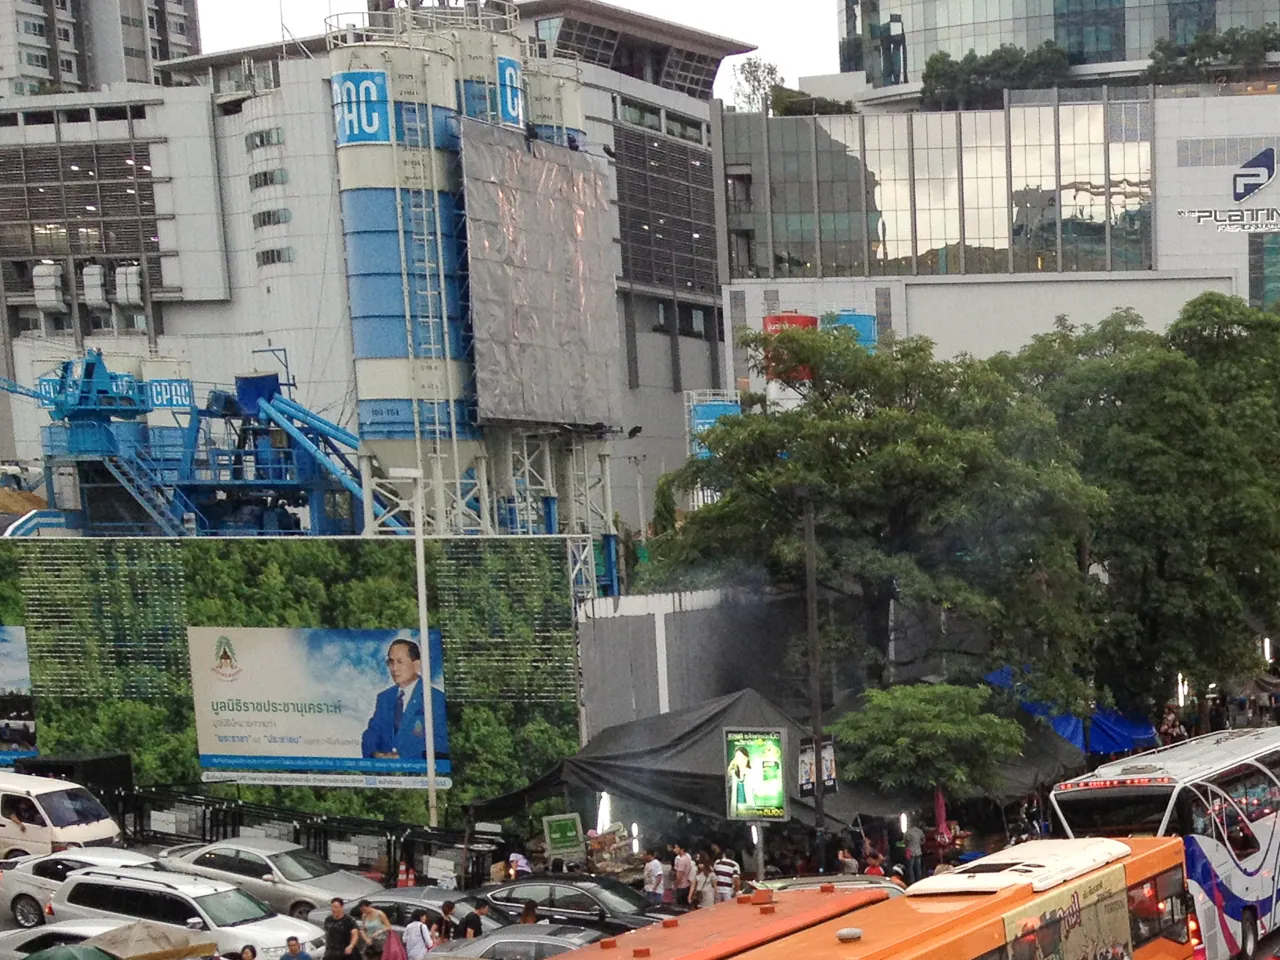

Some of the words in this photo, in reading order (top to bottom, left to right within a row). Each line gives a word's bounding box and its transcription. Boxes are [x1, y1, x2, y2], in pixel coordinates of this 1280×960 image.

[152, 383, 190, 405] CPAC
[211, 699, 342, 717] มูลนิธิราชประชานุเคราะห์
